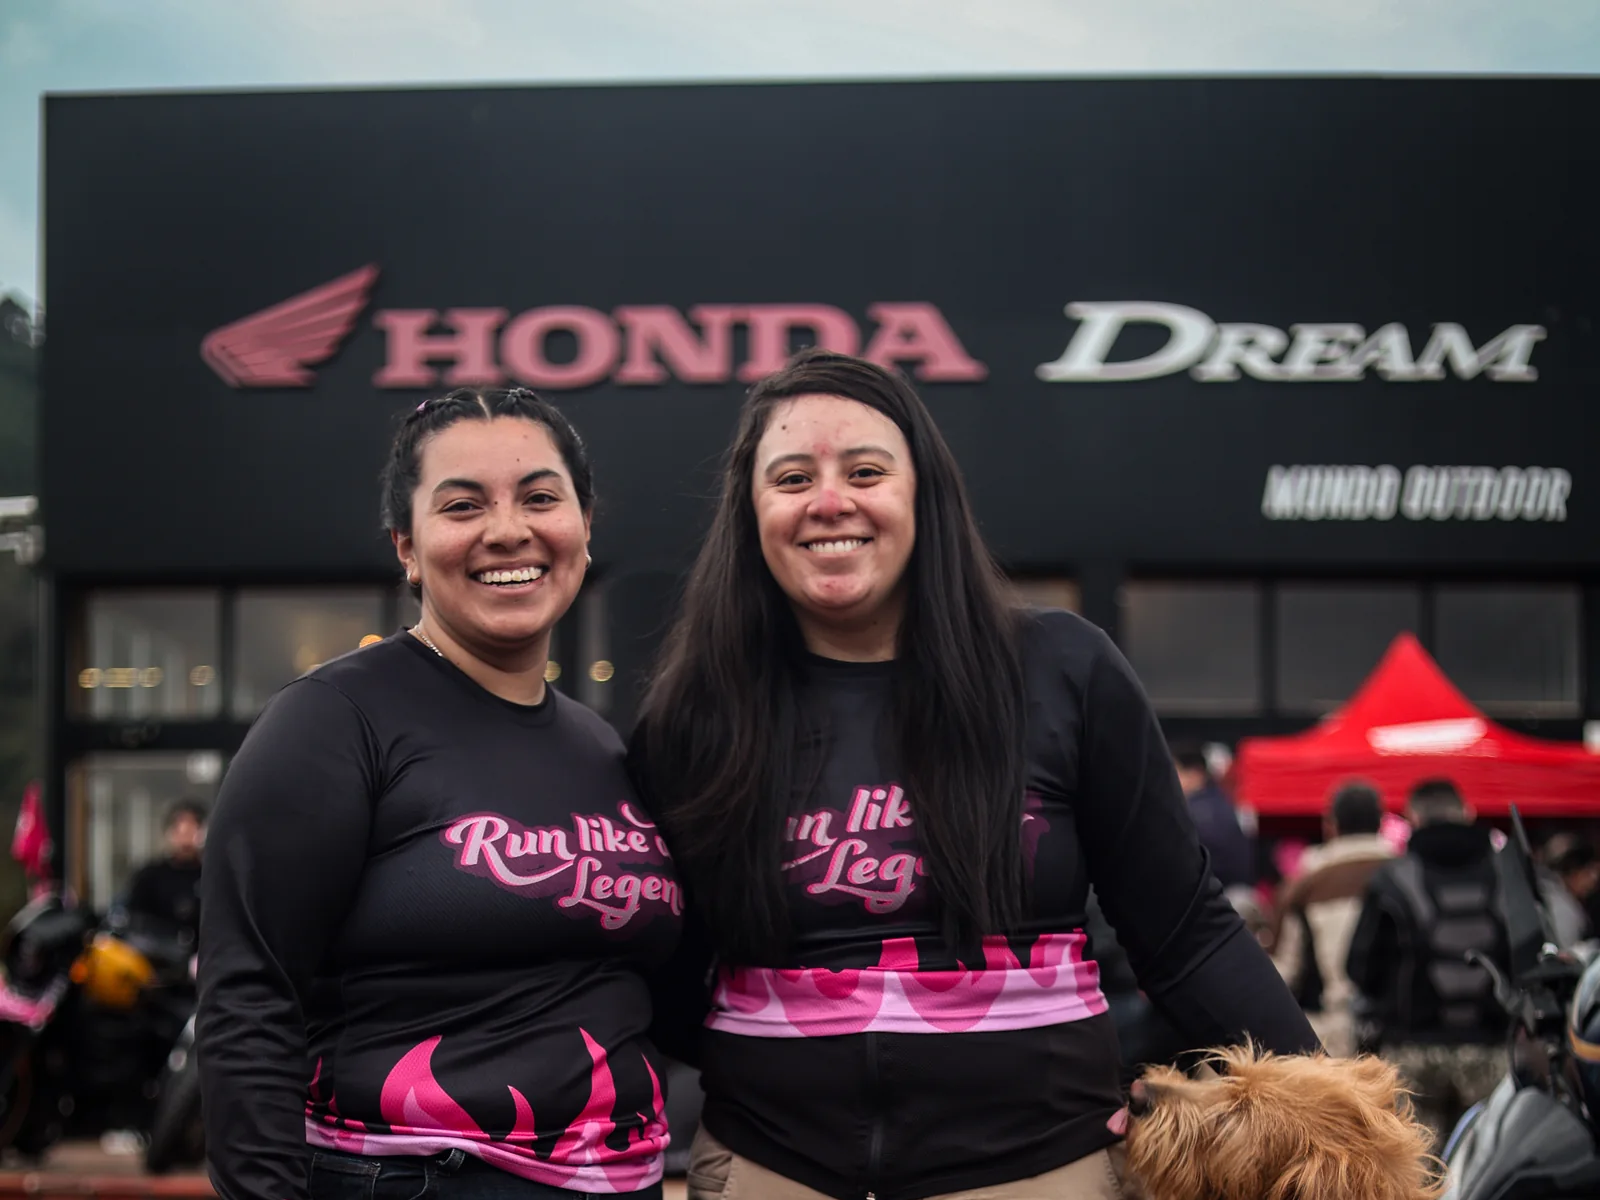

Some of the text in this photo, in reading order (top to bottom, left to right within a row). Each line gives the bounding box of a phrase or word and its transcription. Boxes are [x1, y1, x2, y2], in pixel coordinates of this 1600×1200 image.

[373, 302, 989, 388] HONDA
[1036, 300, 1547, 382] DREAM
[1261, 464, 1572, 522] MUNDO OUTDOOR
[846, 785, 914, 832] lik
[445, 816, 577, 886] Run
[575, 814, 650, 853] like
[558, 856, 685, 930] Legen
